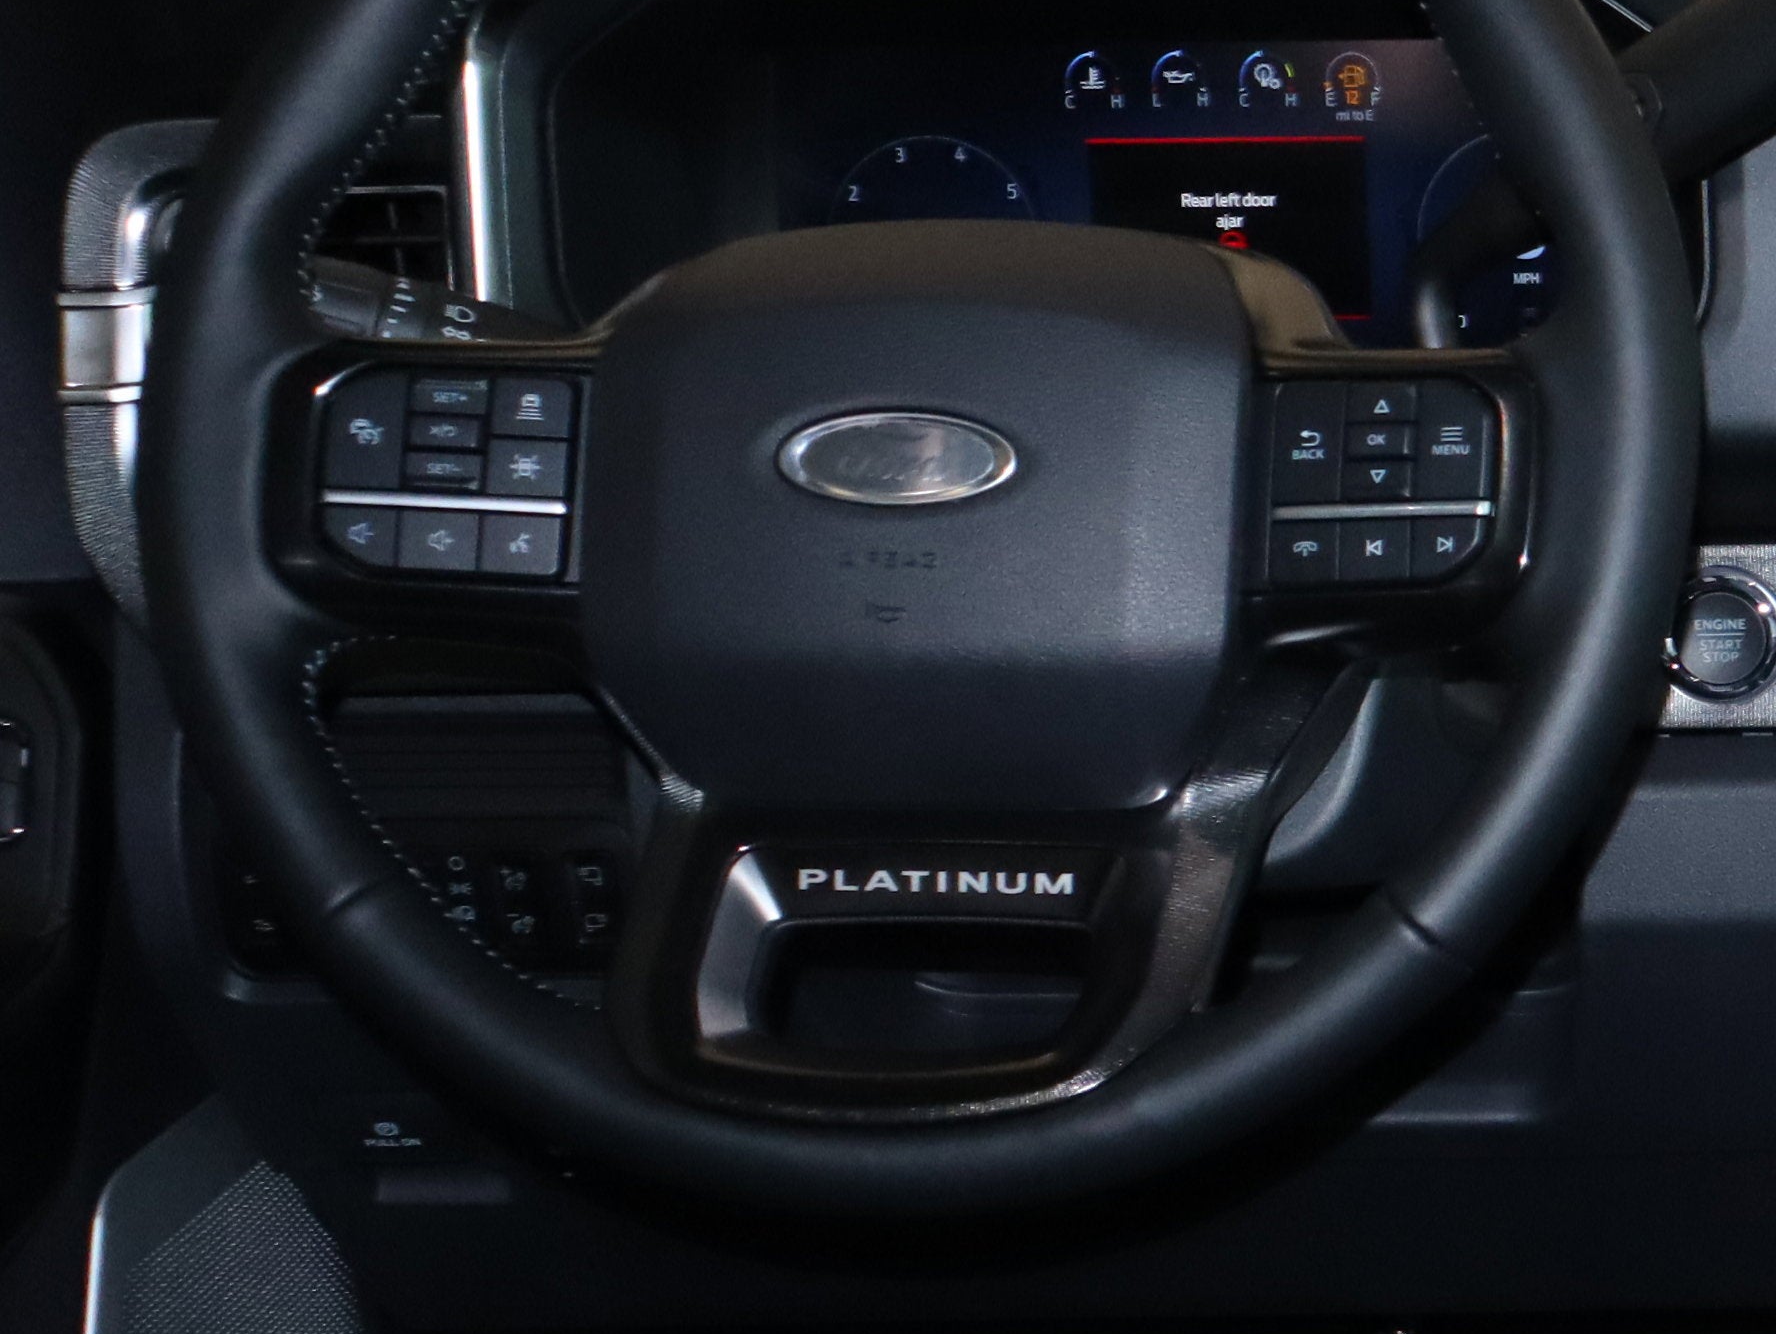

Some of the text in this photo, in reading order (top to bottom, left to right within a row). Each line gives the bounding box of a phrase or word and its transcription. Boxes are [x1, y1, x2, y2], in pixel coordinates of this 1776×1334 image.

[1064, 94, 1076, 109] C
[1110, 94, 1123, 108] H
[1152, 94, 1162, 107] L
[1197, 94, 1209, 107] H
[1238, 93, 1250, 108] C
[1285, 94, 1297, 107] H
[1325, 93, 1337, 106] E
[1345, 91, 1359, 105] 12
[1370, 92, 1381, 106] F
[894, 147, 905, 163] 3
[954, 146, 966, 162] 4
[847, 185, 859, 202] 2
[1006, 183, 1018, 199] 5
[1180, 192, 1277, 208] Rear left door
[1215, 213, 1245, 231] ajar
[1513, 272, 1541, 284] MPH
[1366, 434, 1386, 446] OK
[1291, 448, 1325, 461] BACK
[1431, 443, 1471, 456] MENU
[1694, 618, 1747, 631] ENGINE
[1699, 638, 1744, 651] START
[1703, 651, 1740, 663] STOP
[798, 868, 1075, 896] PLATINUM
